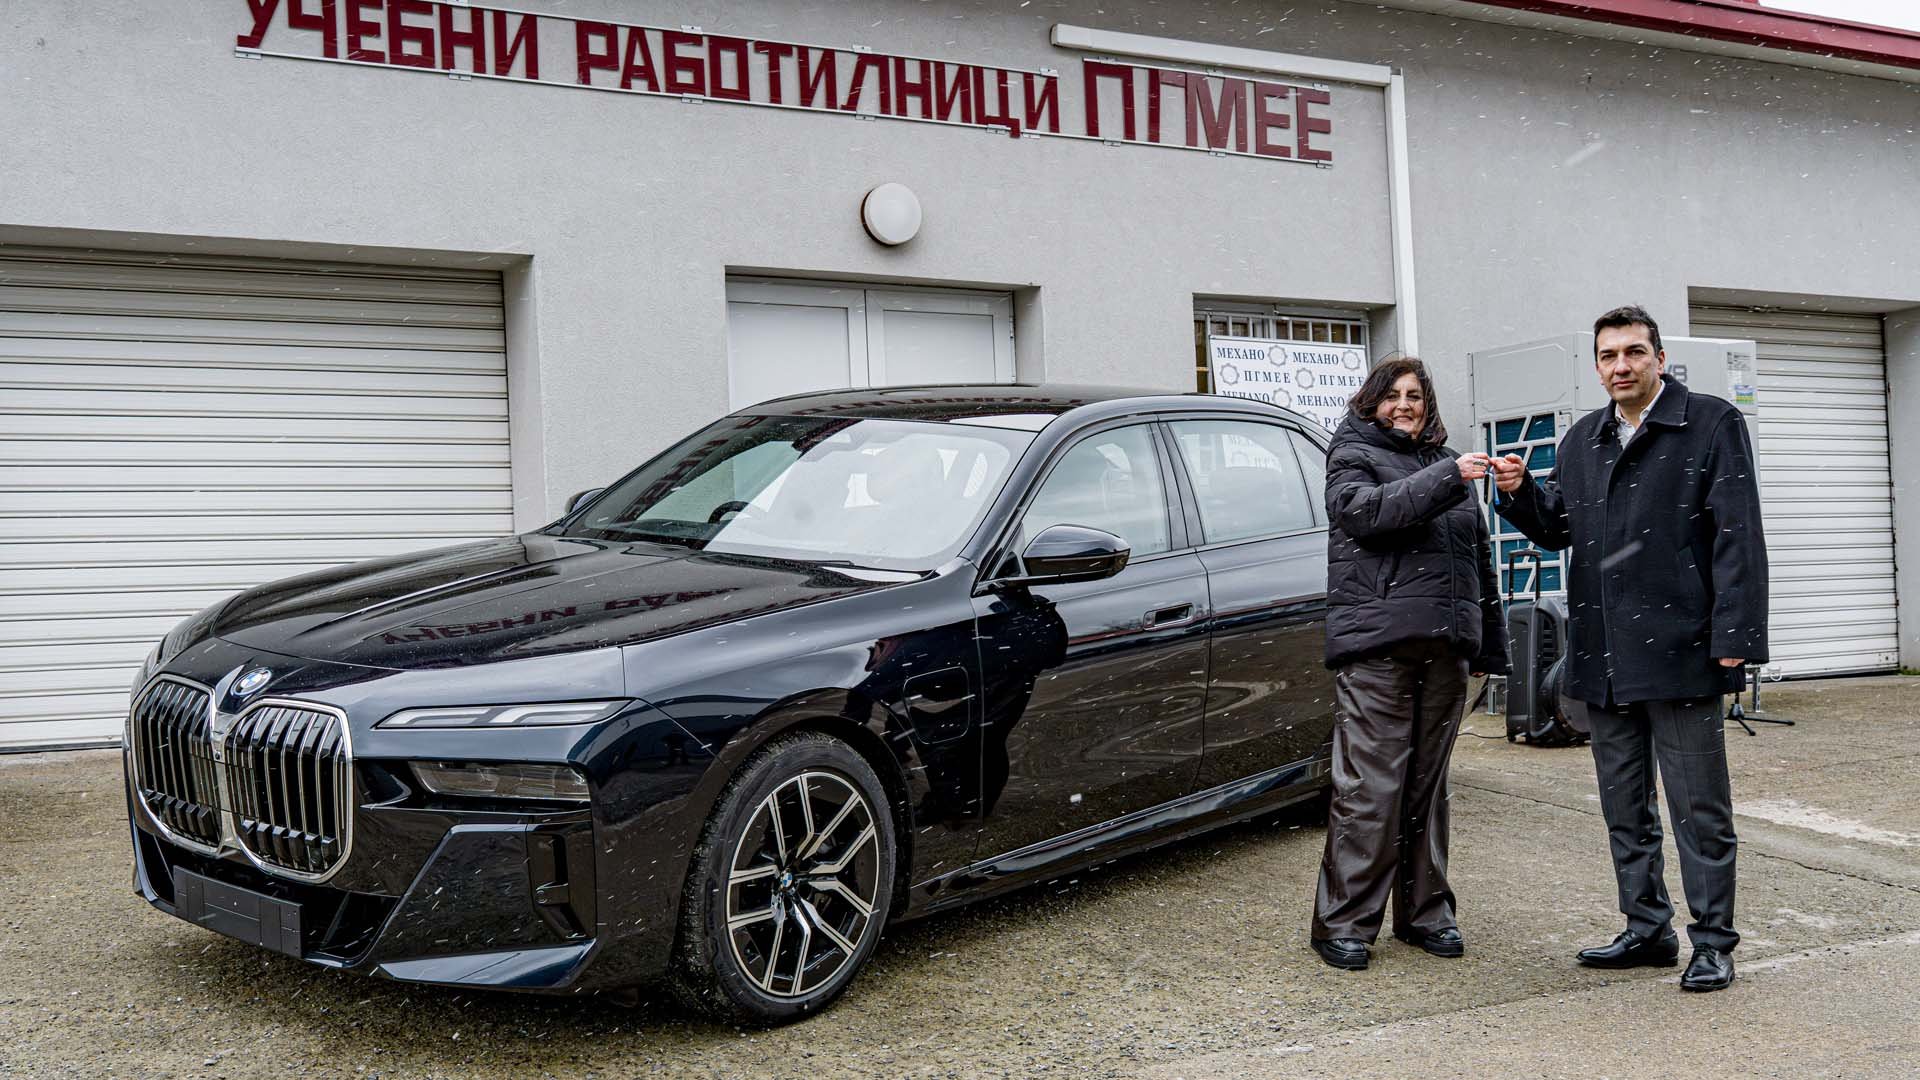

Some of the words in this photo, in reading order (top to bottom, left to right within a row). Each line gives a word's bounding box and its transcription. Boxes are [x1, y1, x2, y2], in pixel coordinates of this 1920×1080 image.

[236, 0, 539, 80] УЧЕБНИ
[576, 21, 1061, 138] РАБОТИЛНИЦИ
[1084, 61, 1332, 161] ПГМЕЕ
[1217, 347, 1265, 360] МЕХАНО
[1293, 352, 1339, 365] МЕХАНО
[1244, 370, 1291, 383] ПГМЕЕ
[1297, 394, 1345, 407] MEHANO
